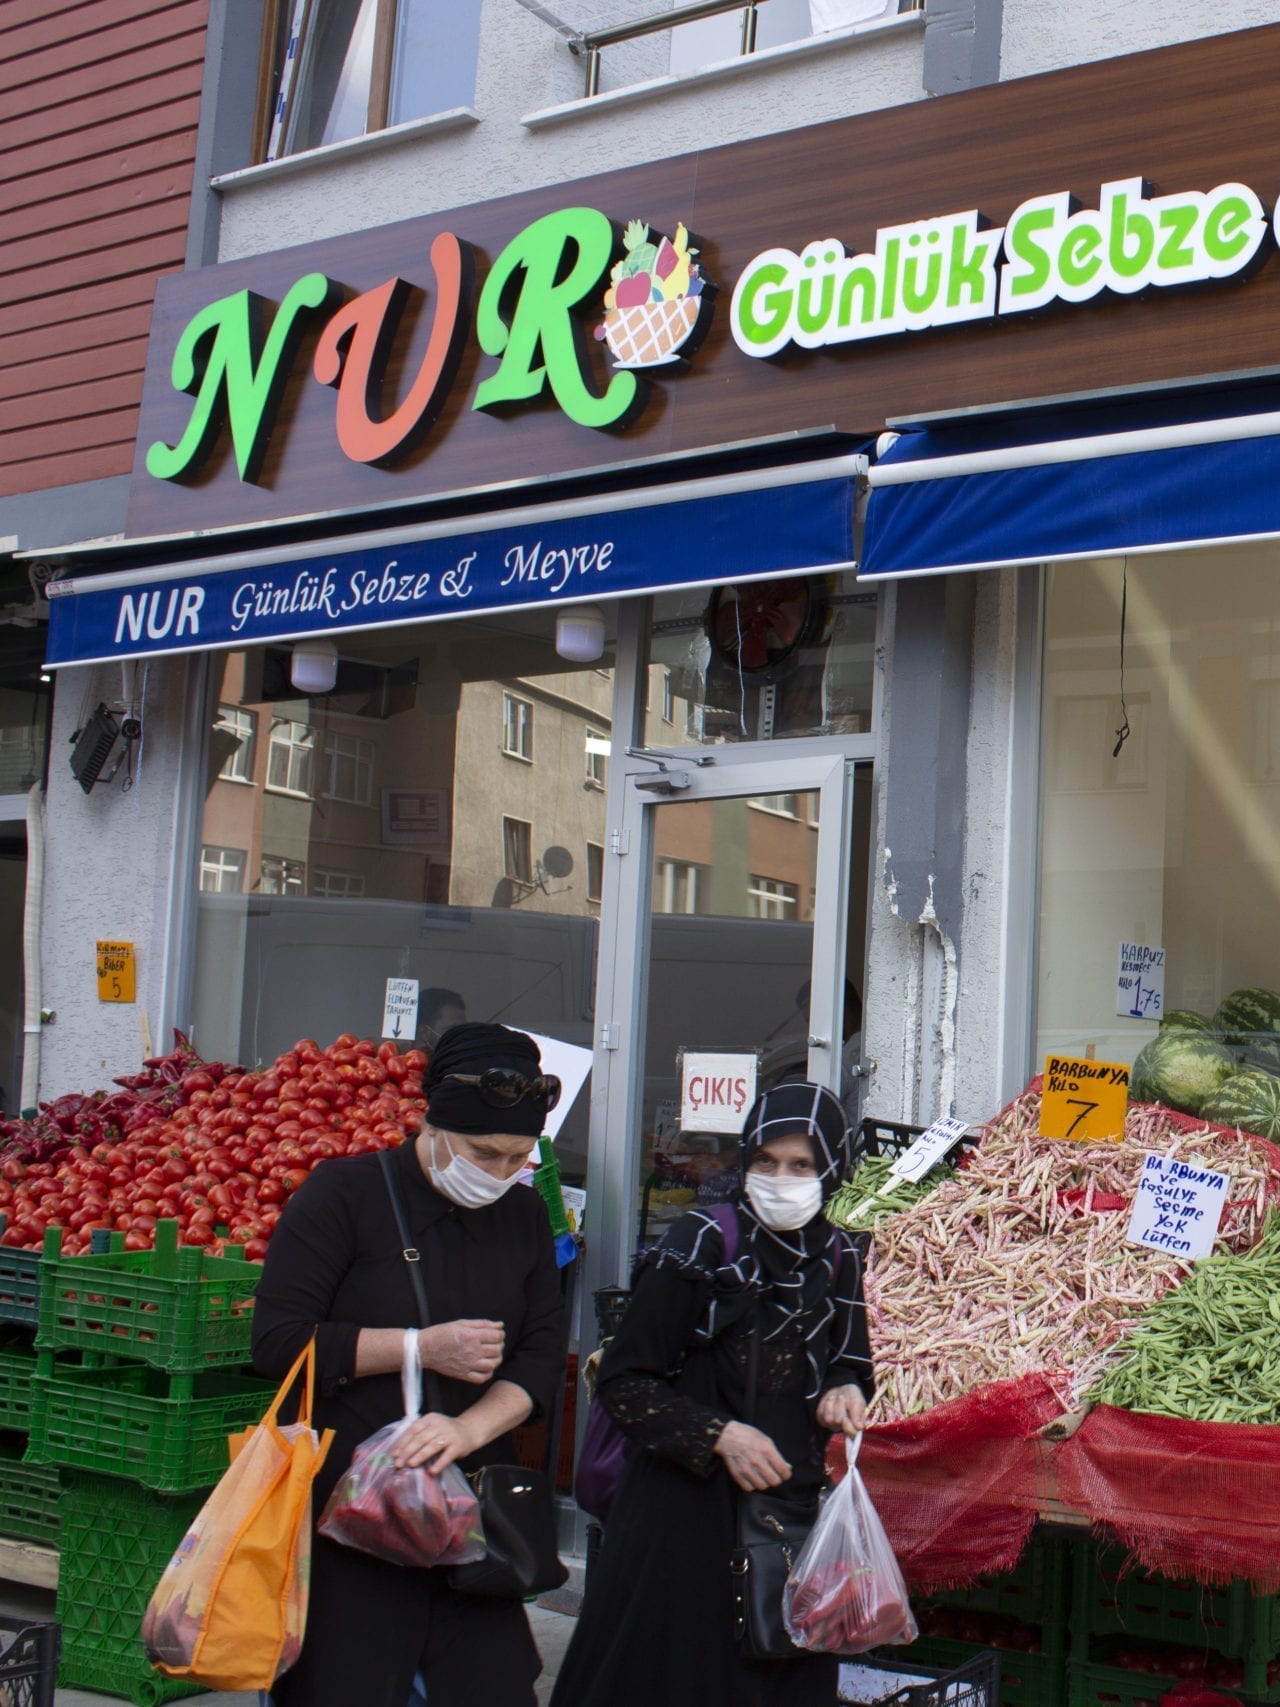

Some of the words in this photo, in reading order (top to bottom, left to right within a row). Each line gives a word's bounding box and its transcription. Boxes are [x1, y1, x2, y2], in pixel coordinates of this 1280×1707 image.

[739, 226, 989, 345] Günlük
[1012, 194, 1252, 296] Sebze
[146, 206, 637, 484] NUR
[114, 586, 205, 643] NUR
[231, 567, 341, 632] Günlük
[340, 561, 429, 611] Sebze
[439, 552, 478, 598] &
[500, 540, 614, 593] Meyve
[1121, 943, 1164, 967] KARPUZ
[112, 976, 122, 999] 5
[1048, 1058, 1130, 1087] BARBUNYA
[688, 1076, 747, 1114] ÇIKIŞ
[1065, 1098, 1100, 1137] 7
[897, 1147, 931, 1174] 5
